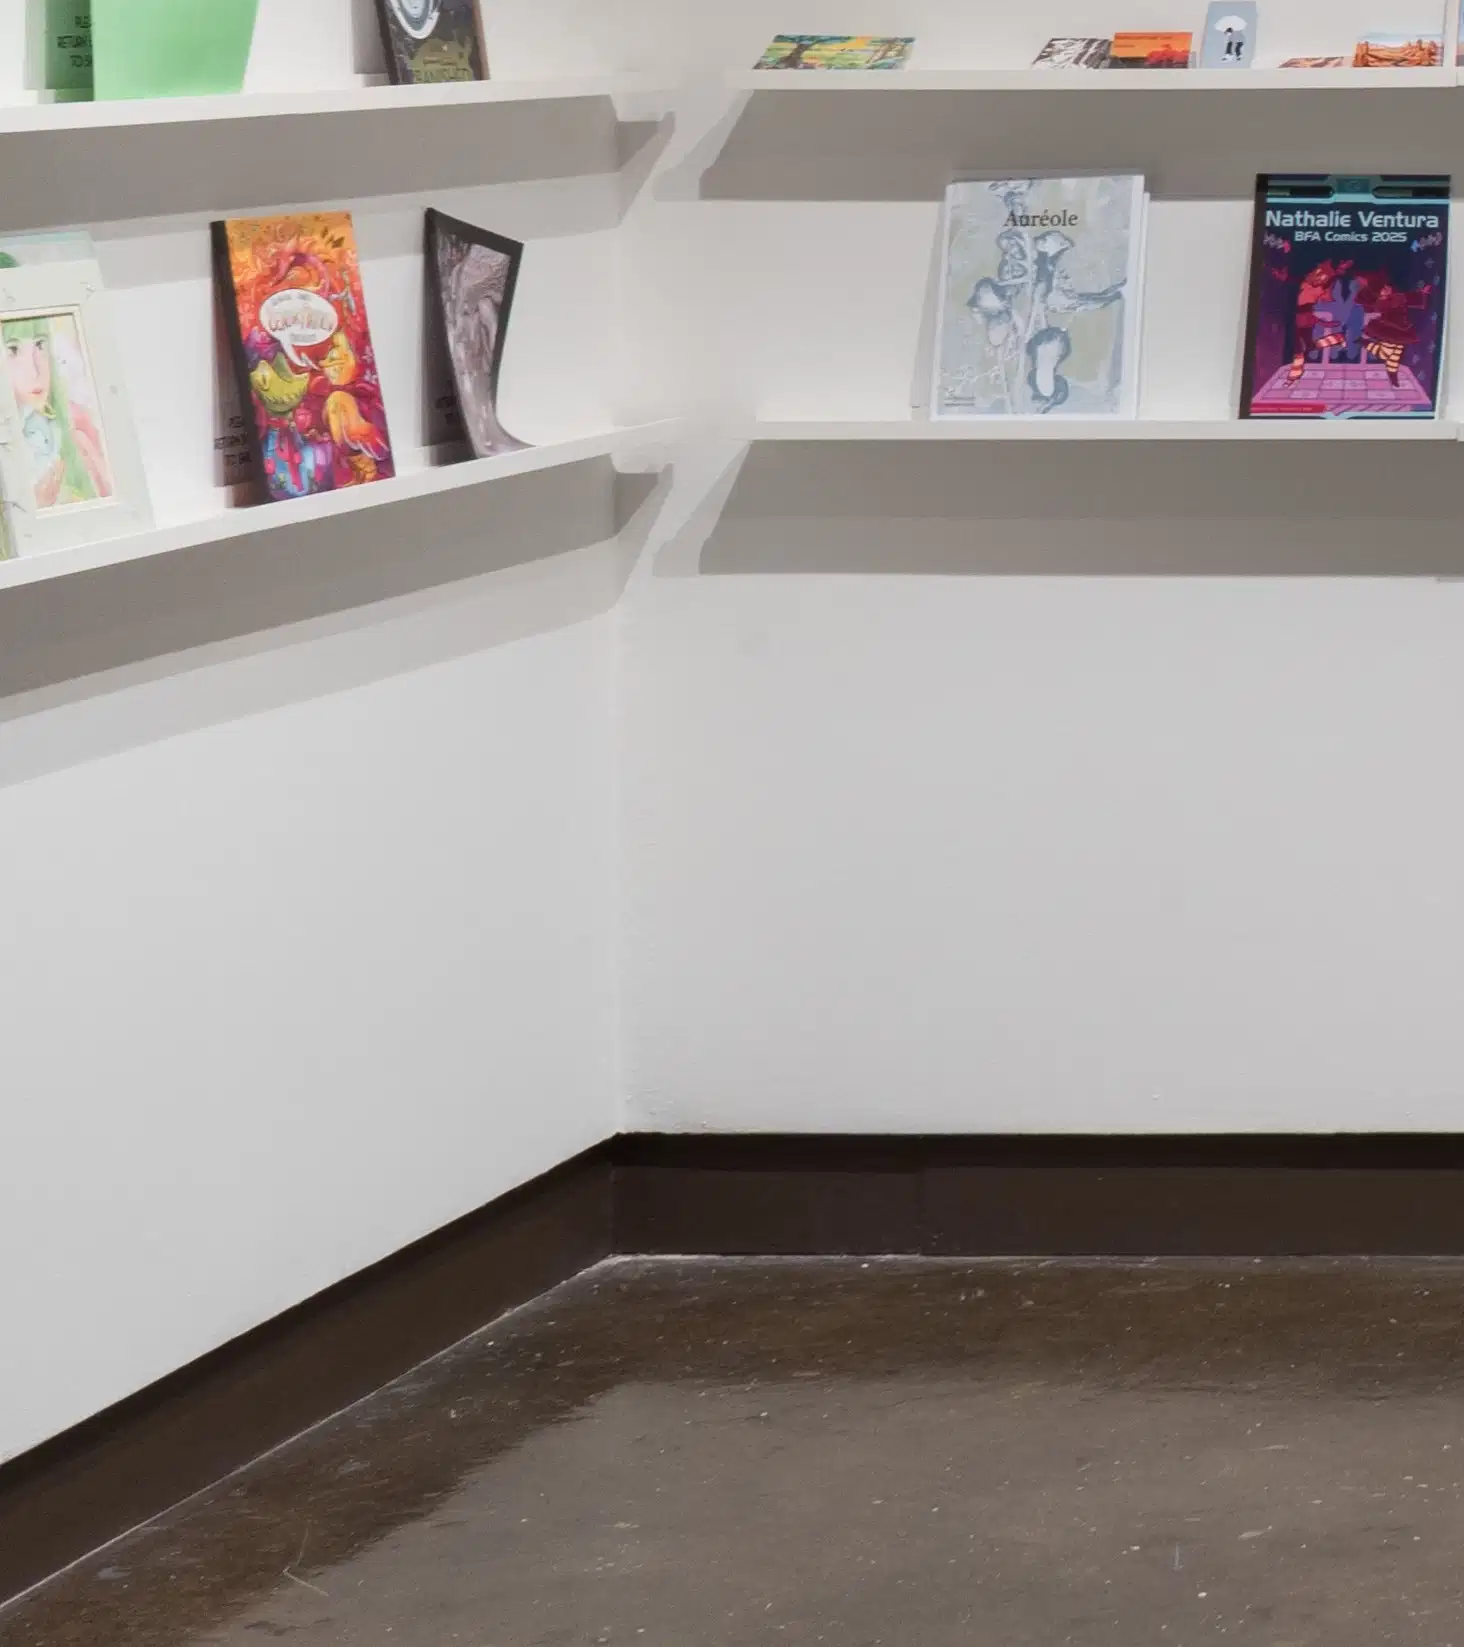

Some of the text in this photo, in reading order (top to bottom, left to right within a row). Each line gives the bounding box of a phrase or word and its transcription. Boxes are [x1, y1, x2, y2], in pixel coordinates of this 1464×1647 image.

[1003, 208, 1080, 228] Auréole
[1265, 210, 1439, 228] Nathalie Ventura
[1294, 231, 1408, 243] BFA Comics 2025
